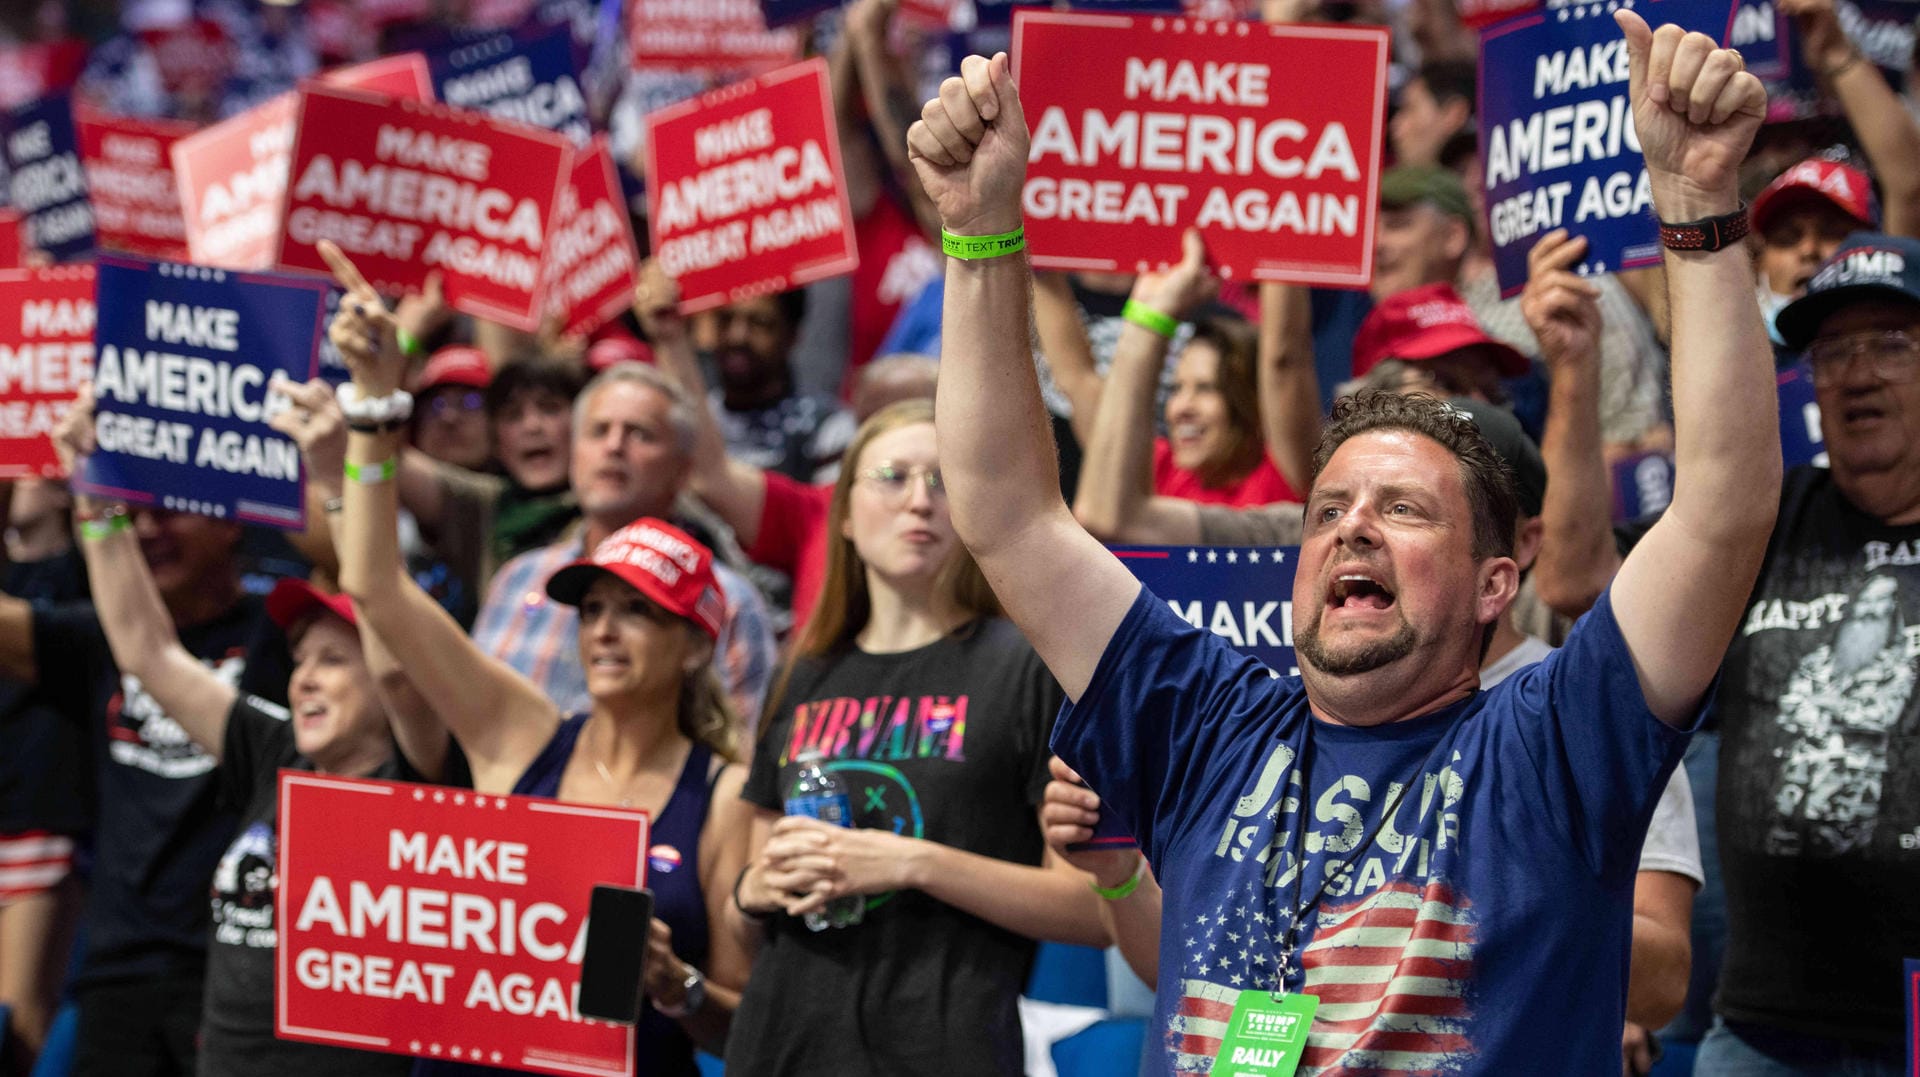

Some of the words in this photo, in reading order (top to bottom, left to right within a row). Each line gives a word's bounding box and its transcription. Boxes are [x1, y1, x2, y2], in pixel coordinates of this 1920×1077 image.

[1124, 56, 1271, 107] MAKE
[1533, 38, 1630, 99] MAKE
[375, 124, 492, 182] MAKE
[694, 107, 776, 166] MAKE
[1028, 104, 1361, 181] AMERICA
[1486, 95, 1644, 190] AMERIC
[294, 153, 544, 251] AMERICA
[656, 139, 833, 234] AMERICA
[1021, 176, 1189, 226] GREAT
[1195, 186, 1360, 237] AGAIN
[1490, 180, 1573, 247] GREAT
[1574, 168, 1655, 223] AGA
[288, 206, 424, 261] GREAT
[421, 230, 541, 291] AGAIN
[657, 220, 749, 278] GREAT
[750, 195, 842, 254] AGAIN
[966, 241, 995, 252] TEXT
[21, 297, 97, 339] MAK
[145, 299, 240, 352] MAKE
[94, 343, 295, 424] AMERICA
[95, 411, 193, 464] GREAT
[195, 427, 299, 482] AGAIN
[778, 694, 969, 768] NIRVANA
[387, 828, 529, 886] MAKE
[1215, 818, 1260, 863] IS
[295, 874, 590, 965] AMERIC
[295, 948, 455, 1005] GREAT
[464, 969, 618, 1028] AGAI
[1248, 1012, 1296, 1026] TRUMP
[1248, 1023, 1288, 1033] PENCE
[1231, 1046, 1285, 1068] RALLY
